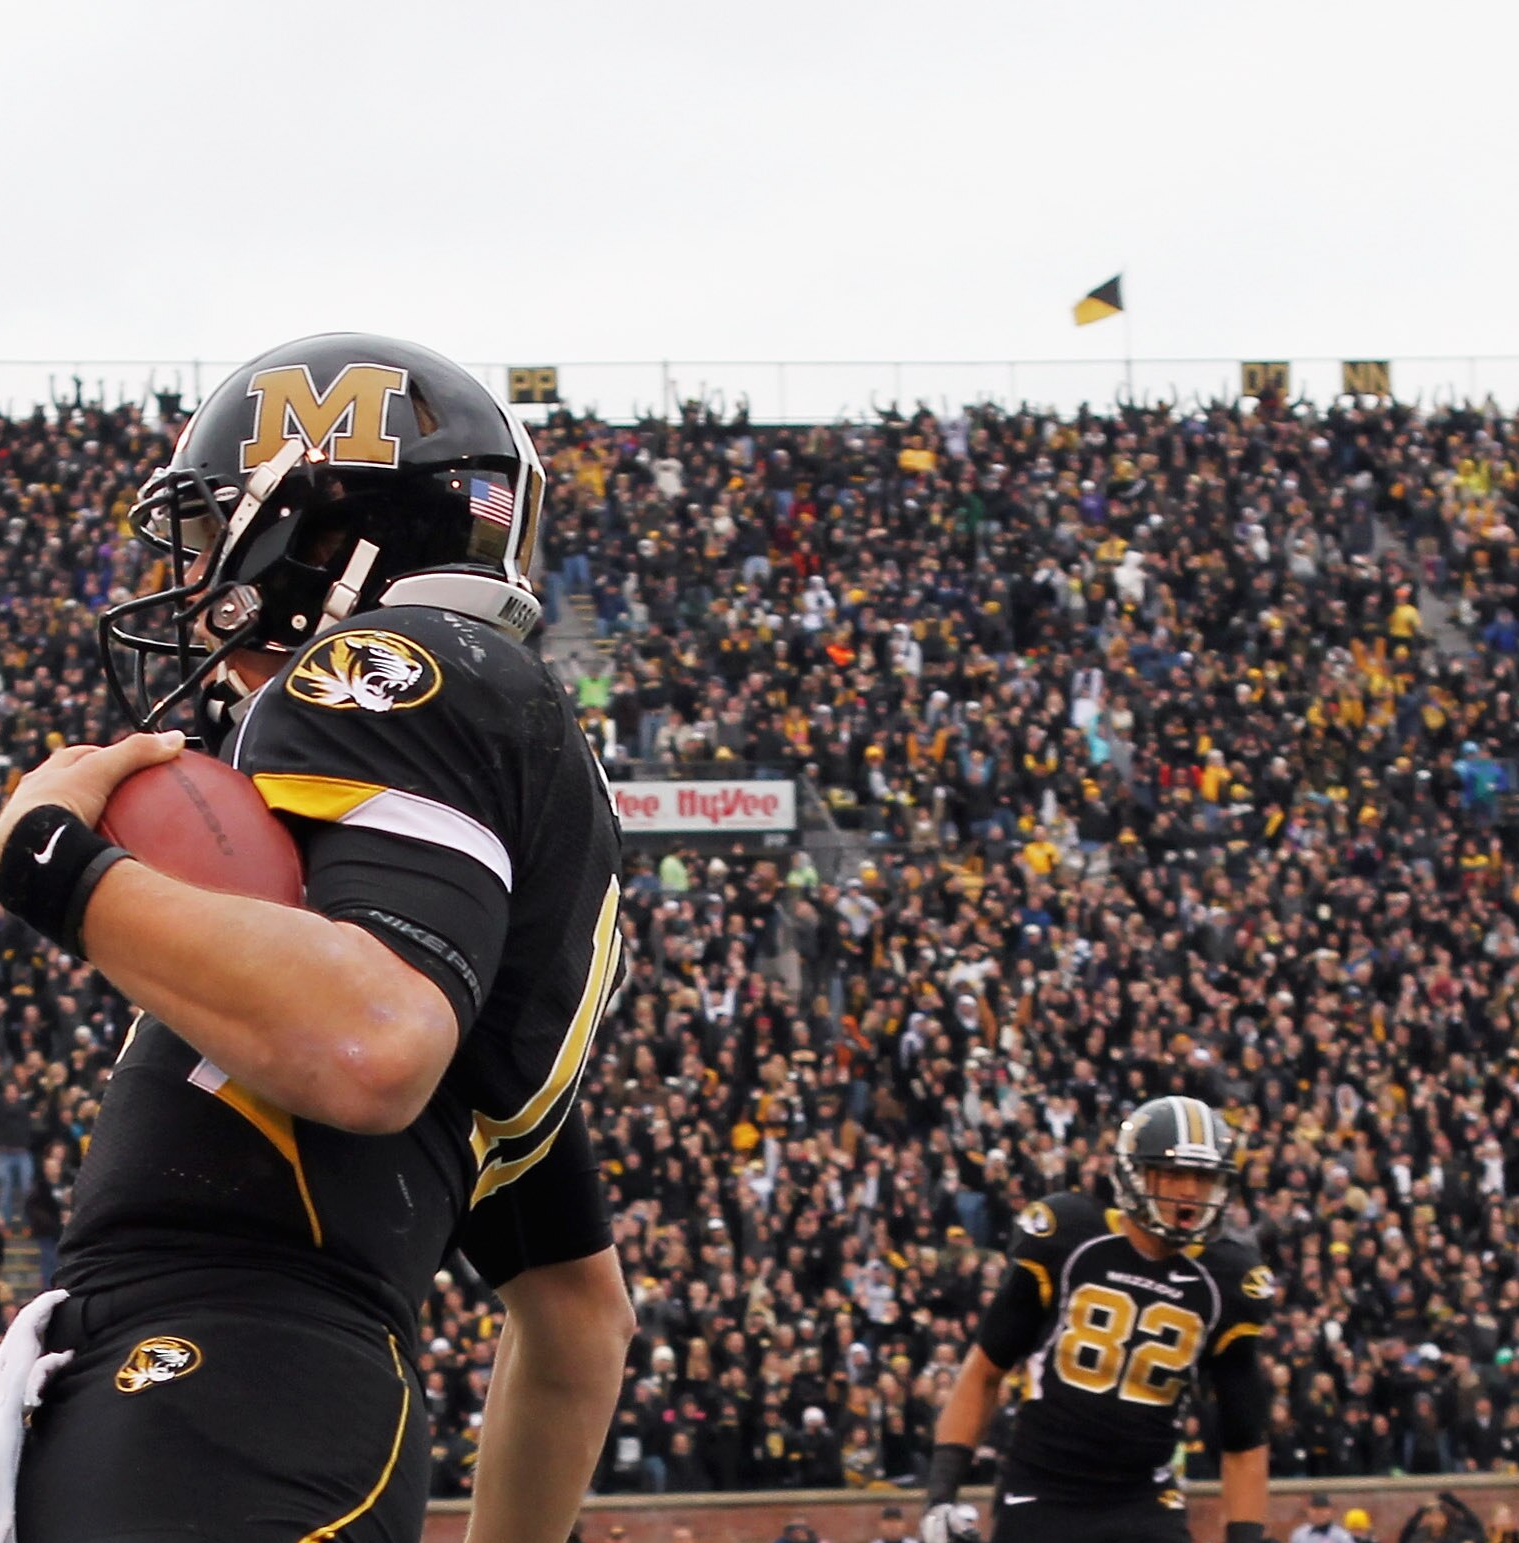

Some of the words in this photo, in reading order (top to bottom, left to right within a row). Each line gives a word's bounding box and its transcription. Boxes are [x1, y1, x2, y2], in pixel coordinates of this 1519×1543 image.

[509, 368, 558, 404] PP
[1344, 361, 1391, 396] NN
[238, 363, 409, 471] M
[677, 788, 780, 823] HyVee
[368, 909, 448, 955] NIKE
[1054, 1282, 1205, 1407] 82
